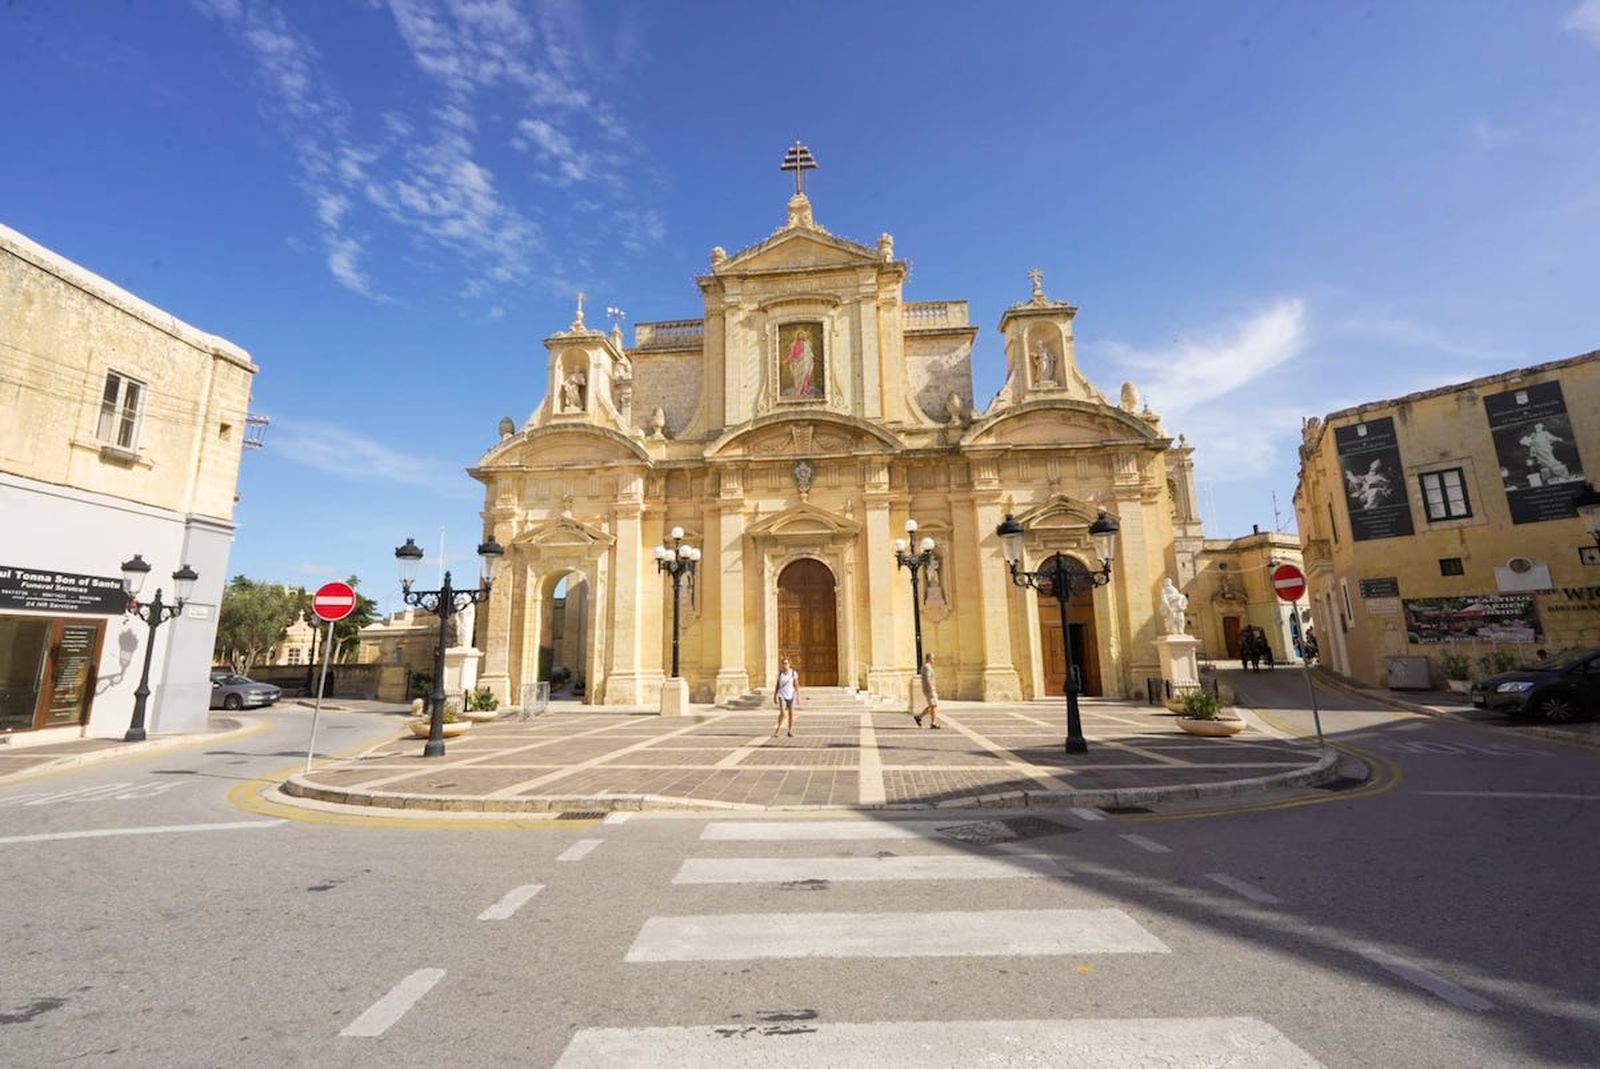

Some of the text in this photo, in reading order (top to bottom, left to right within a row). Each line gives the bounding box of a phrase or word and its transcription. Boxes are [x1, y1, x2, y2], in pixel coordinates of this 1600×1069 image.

[15, 571, 52, 582] Tonna
[55, 574, 76, 585] Son
[78, 578, 90, 586] of
[92, 579, 121, 589] Santu
[20, 581, 88, 593] Funeral Services
[25, 600, 36, 608] 24
